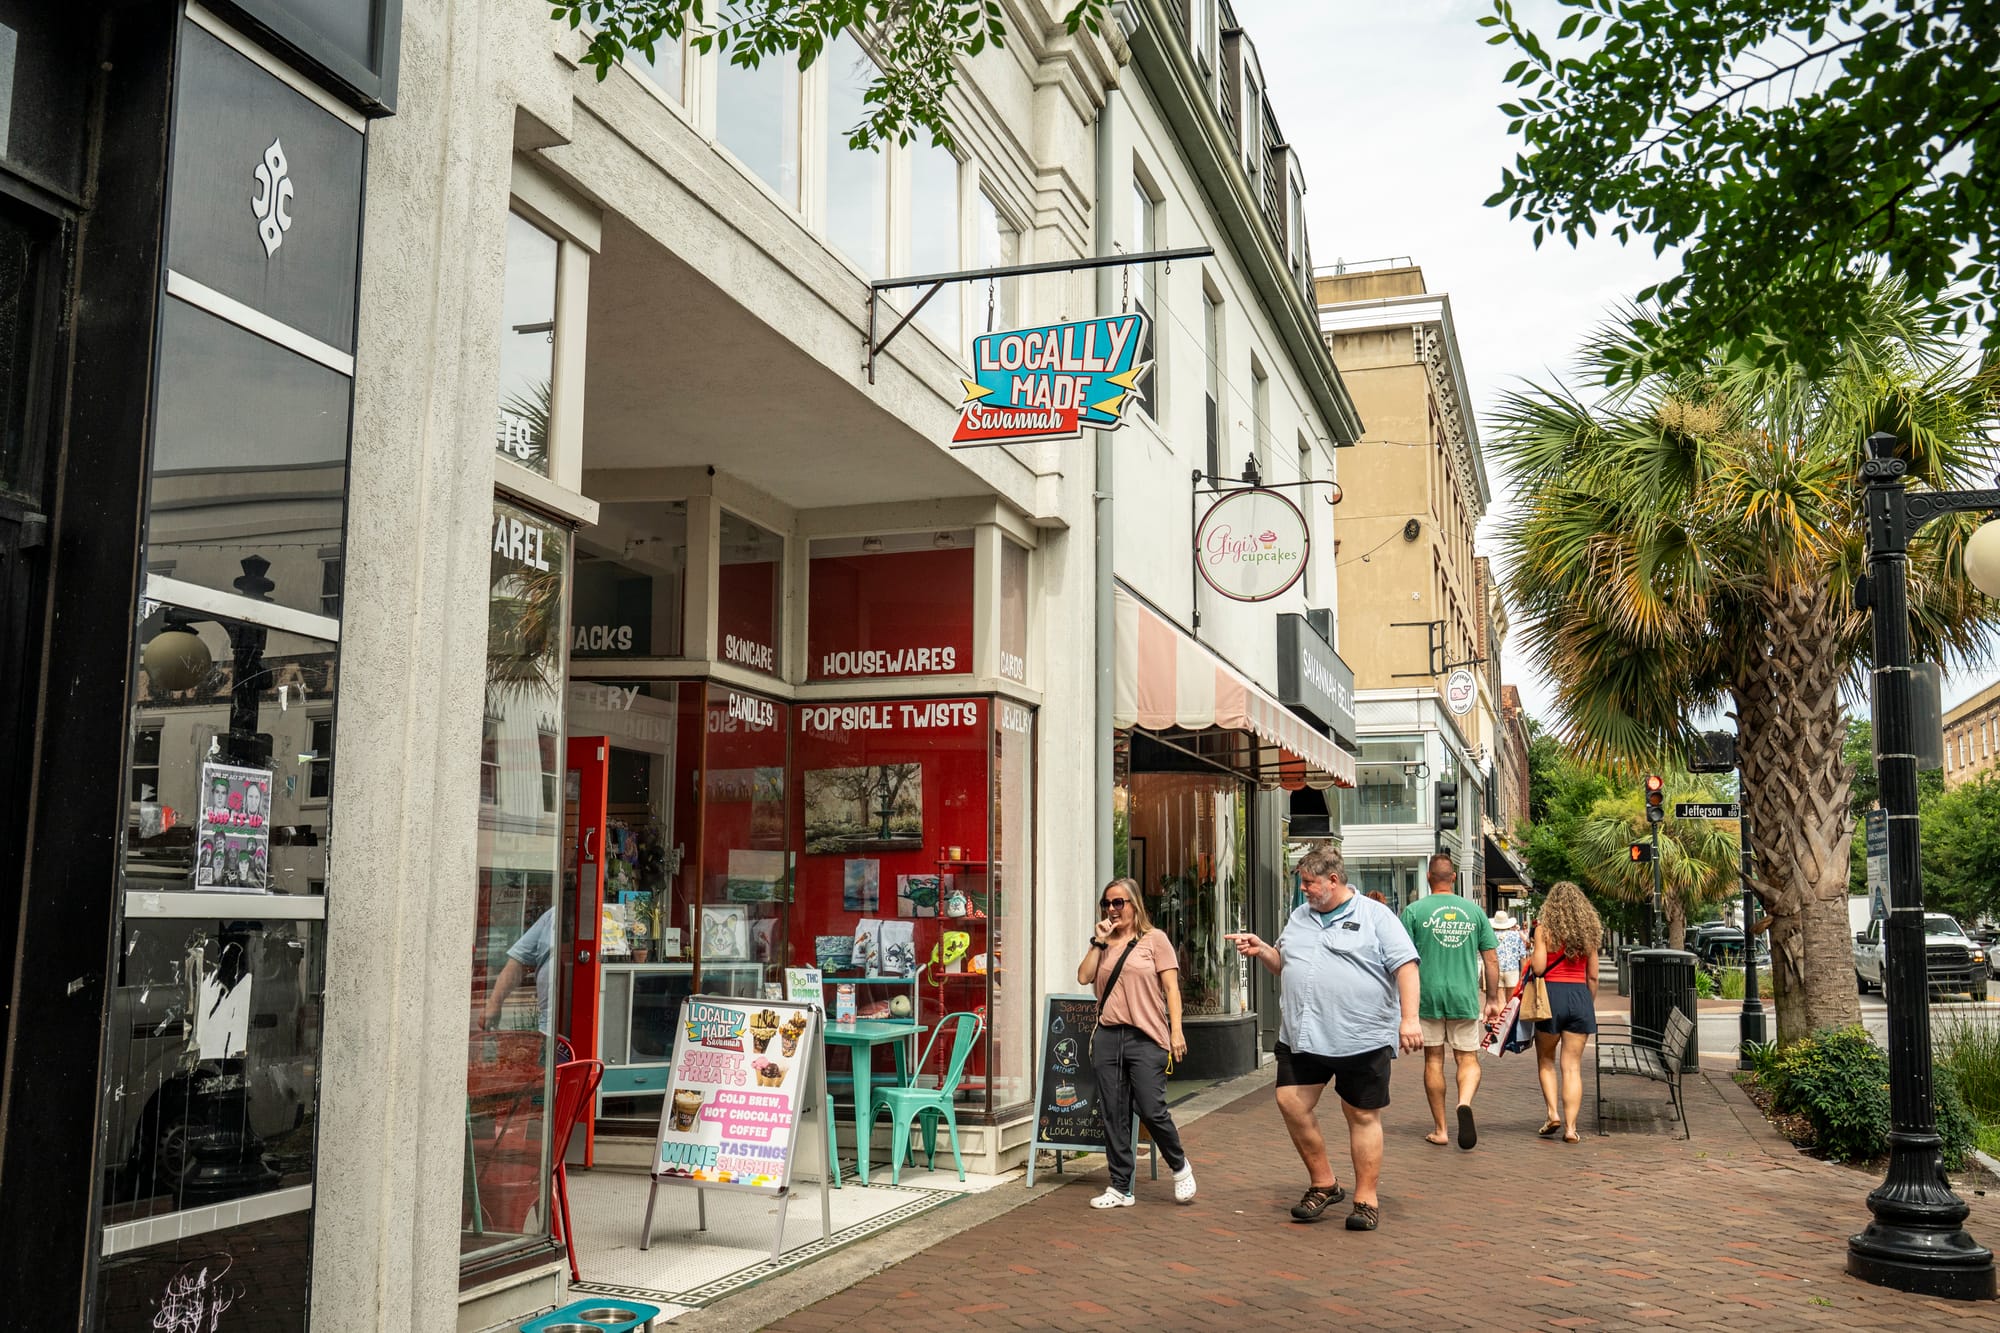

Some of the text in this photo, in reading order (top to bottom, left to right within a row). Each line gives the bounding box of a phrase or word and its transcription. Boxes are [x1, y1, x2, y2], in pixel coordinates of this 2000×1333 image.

[980, 317, 1136, 372] LOCALLY
[1010, 374, 1092, 416] MADE
[966, 401, 1064, 430] Savannah
[1207, 524, 1258, 565] Gigi's
[1241, 548, 1297, 565] cupcakes
[725, 634, 773, 671] SKINCARE
[823, 646, 955, 675] HOUSEWARES
[1000, 651, 1023, 681] CARDS
[1303, 648, 1338, 705] SAVANNAH
[729, 692, 773, 727] CANDLES
[801, 705, 893, 732] POPSICLE
[899, 702, 977, 728] TWISTS
[1001, 703, 1033, 736] JEWELRY
[1682, 804, 1723, 817] Jefferson
[1432, 928, 1472, 936] TOURNAMENT
[1443, 935, 1460, 943] 2025
[806, 973, 818, 983] THC
[691, 1003, 745, 1024] LOCALLY
[701, 1023, 732, 1039] MADE
[706, 1037, 741, 1048] Savannah
[683, 1050, 745, 1068] SWEET
[677, 1065, 747, 1086] TREATS
[719, 1092, 781, 1109] COLD BREW,
[704, 1106, 792, 1125] HOT CHOCOLATE
[1057, 1117, 1074, 1126] PLUS
[1076, 1117, 1094, 1127] SHOP
[729, 1124, 768, 1137] COFFEE
[1049, 1127, 1105, 1139] LOCAL ARTISA
[662, 1141, 789, 1167] WINE TASTINGS
[717, 1156, 785, 1177] SLUSHIES
